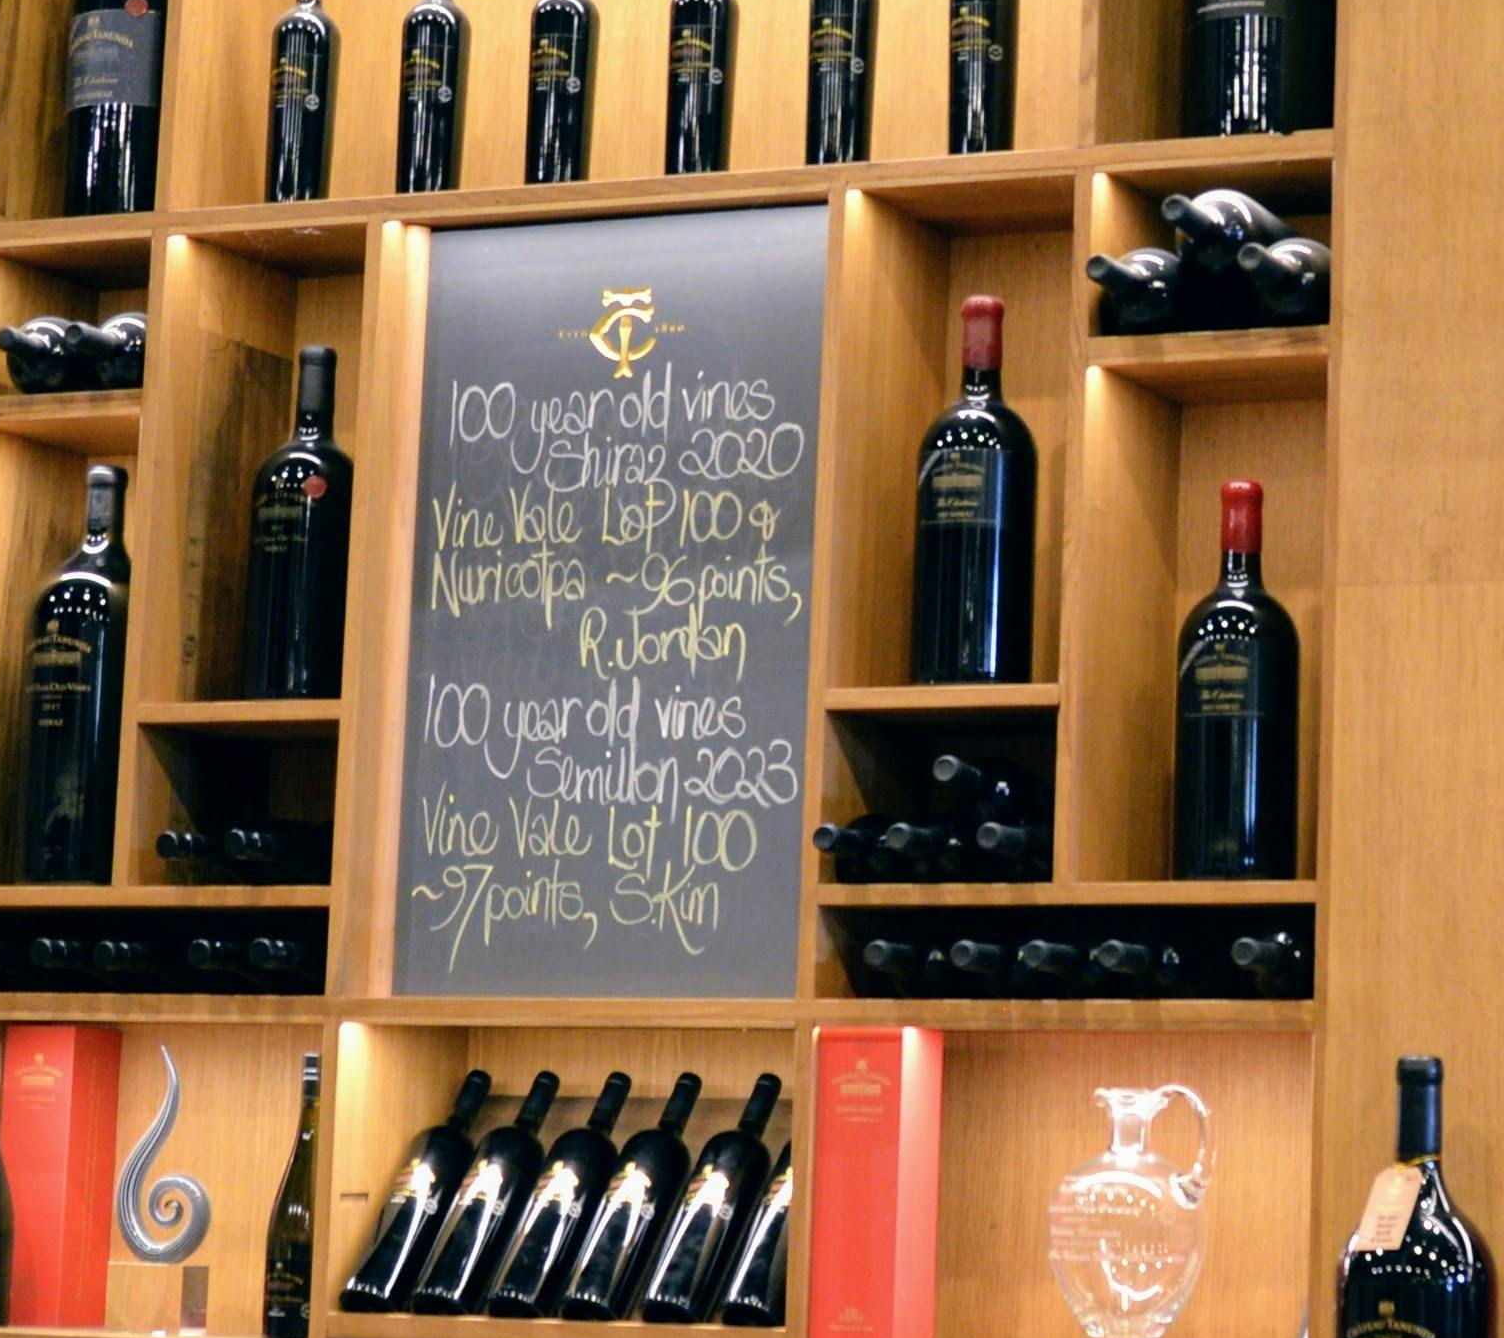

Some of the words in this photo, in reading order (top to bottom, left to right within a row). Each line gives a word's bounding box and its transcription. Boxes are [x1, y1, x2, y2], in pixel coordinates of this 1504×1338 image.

[449, 380, 517, 448] 100
[510, 389, 615, 475] year
[620, 361, 672, 442] old
[682, 370, 776, 422] vines
[432, 481, 505, 551] Vine
[509, 480, 583, 545] Vale
[601, 484, 665, 554] Lot
[679, 489, 743, 549] 100
[544, 432, 677, 528] Shiraz
[679, 422, 805, 481] 2020
[424, 674, 491, 748] 100
[484, 696, 584, 780] year
[586, 675, 641, 747] old
[655, 684, 748, 740] vines
[422, 781, 500, 858] Vine
[509, 795, 593, 860] Vale
[607, 804, 663, 880] Lot
[683, 804, 758, 873] 100
[527, 745, 680, 825] Semillon
[683, 738, 798, 809] 2023
